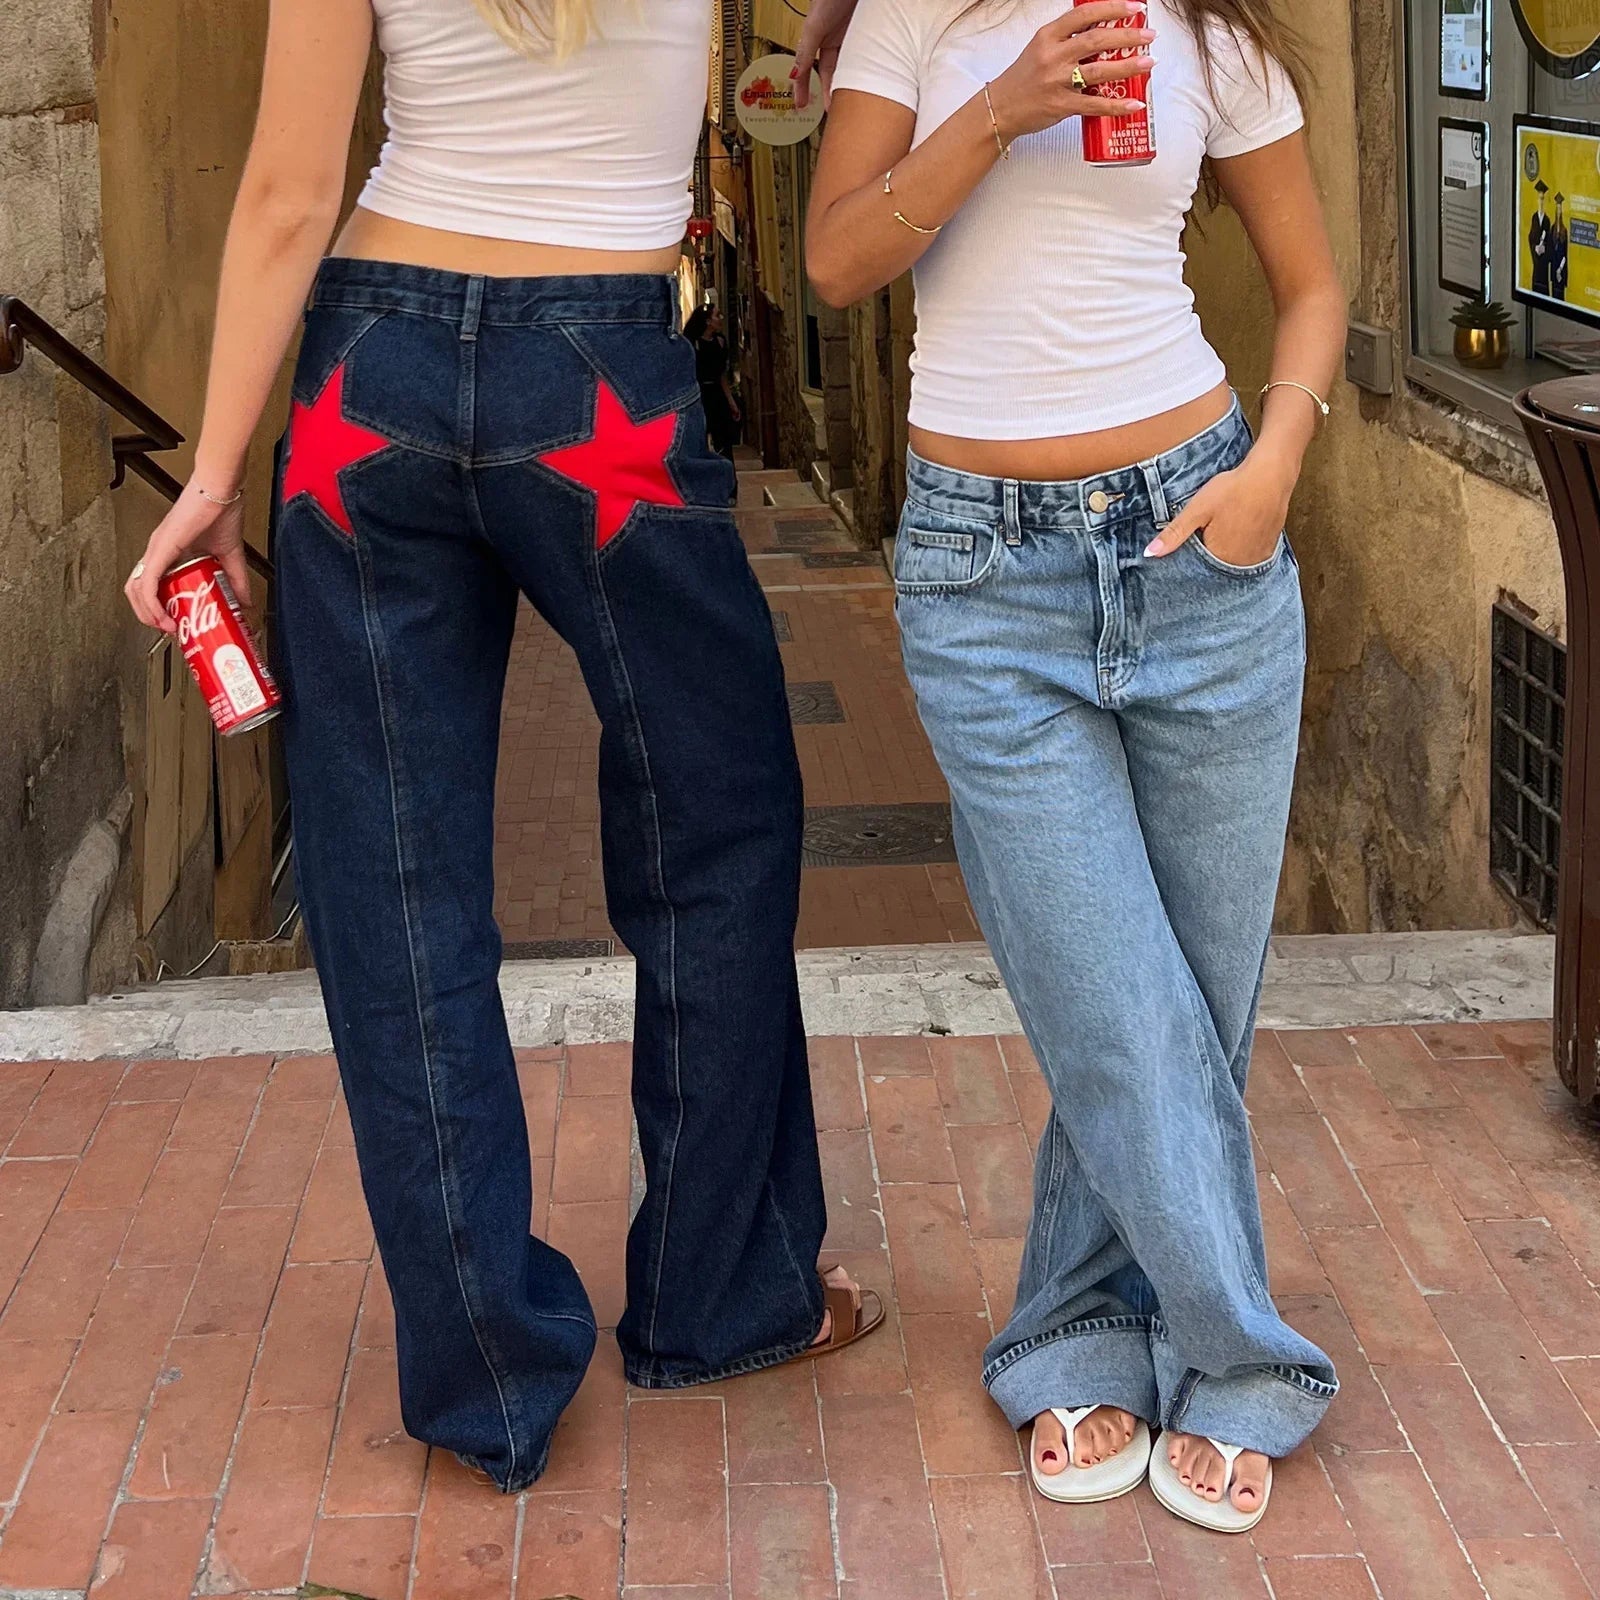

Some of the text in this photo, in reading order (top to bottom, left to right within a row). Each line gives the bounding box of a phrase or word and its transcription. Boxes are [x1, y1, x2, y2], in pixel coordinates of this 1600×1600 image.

[744, 89, 793, 99] Emanesce
[1112, 128, 1139, 138] GAGNER
[1108, 137, 1137, 147] BILLETS
[1110, 145, 1148, 156] PARIS 2024
